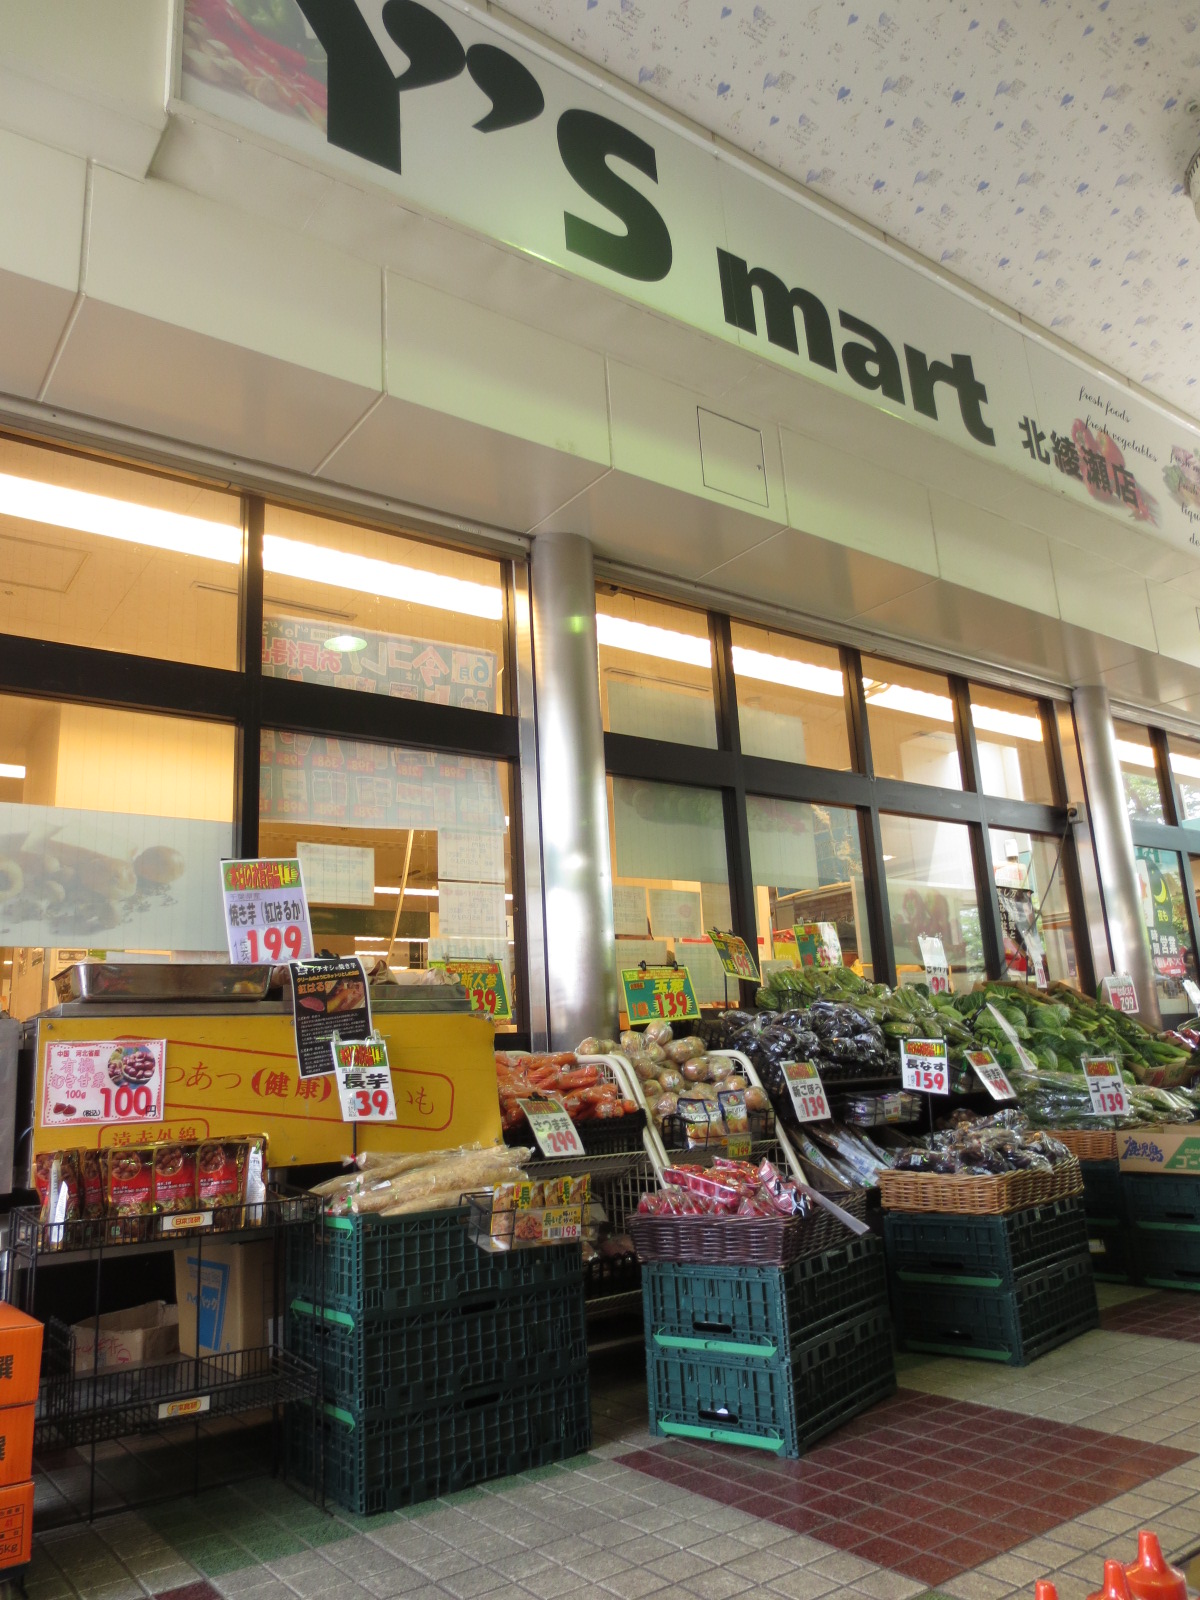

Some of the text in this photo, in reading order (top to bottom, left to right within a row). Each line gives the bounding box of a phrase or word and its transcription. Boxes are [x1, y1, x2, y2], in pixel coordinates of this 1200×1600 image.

[716, 247, 996, 447] mart
[1079, 386, 1131, 423] fresh foods
[1086, 415, 1158, 462] fresh vegetables
[1018, 415, 1139, 509] 北綾瀬店
[247, 925, 302, 964] 199
[654, 991, 687, 1019] 139
[60, 1058, 95, 1074] 有機
[906, 1058, 945, 1073] 長なす
[51, 1072, 105, 1089] むき甘栗
[343, 1073, 389, 1089] 長芋
[914, 1071, 945, 1091] 159
[1090, 1081, 1121, 1093] ゴーヤ
[65, 1090, 86, 1099] 100g
[355, 1089, 389, 1117] 39
[1100, 1093, 1124, 1113] 139
[802, 1095, 826, 1118] 139
[534, 1117, 571, 1131] さつま芋
[547, 1131, 577, 1153] 299
[561, 1225, 577, 1238] 198
